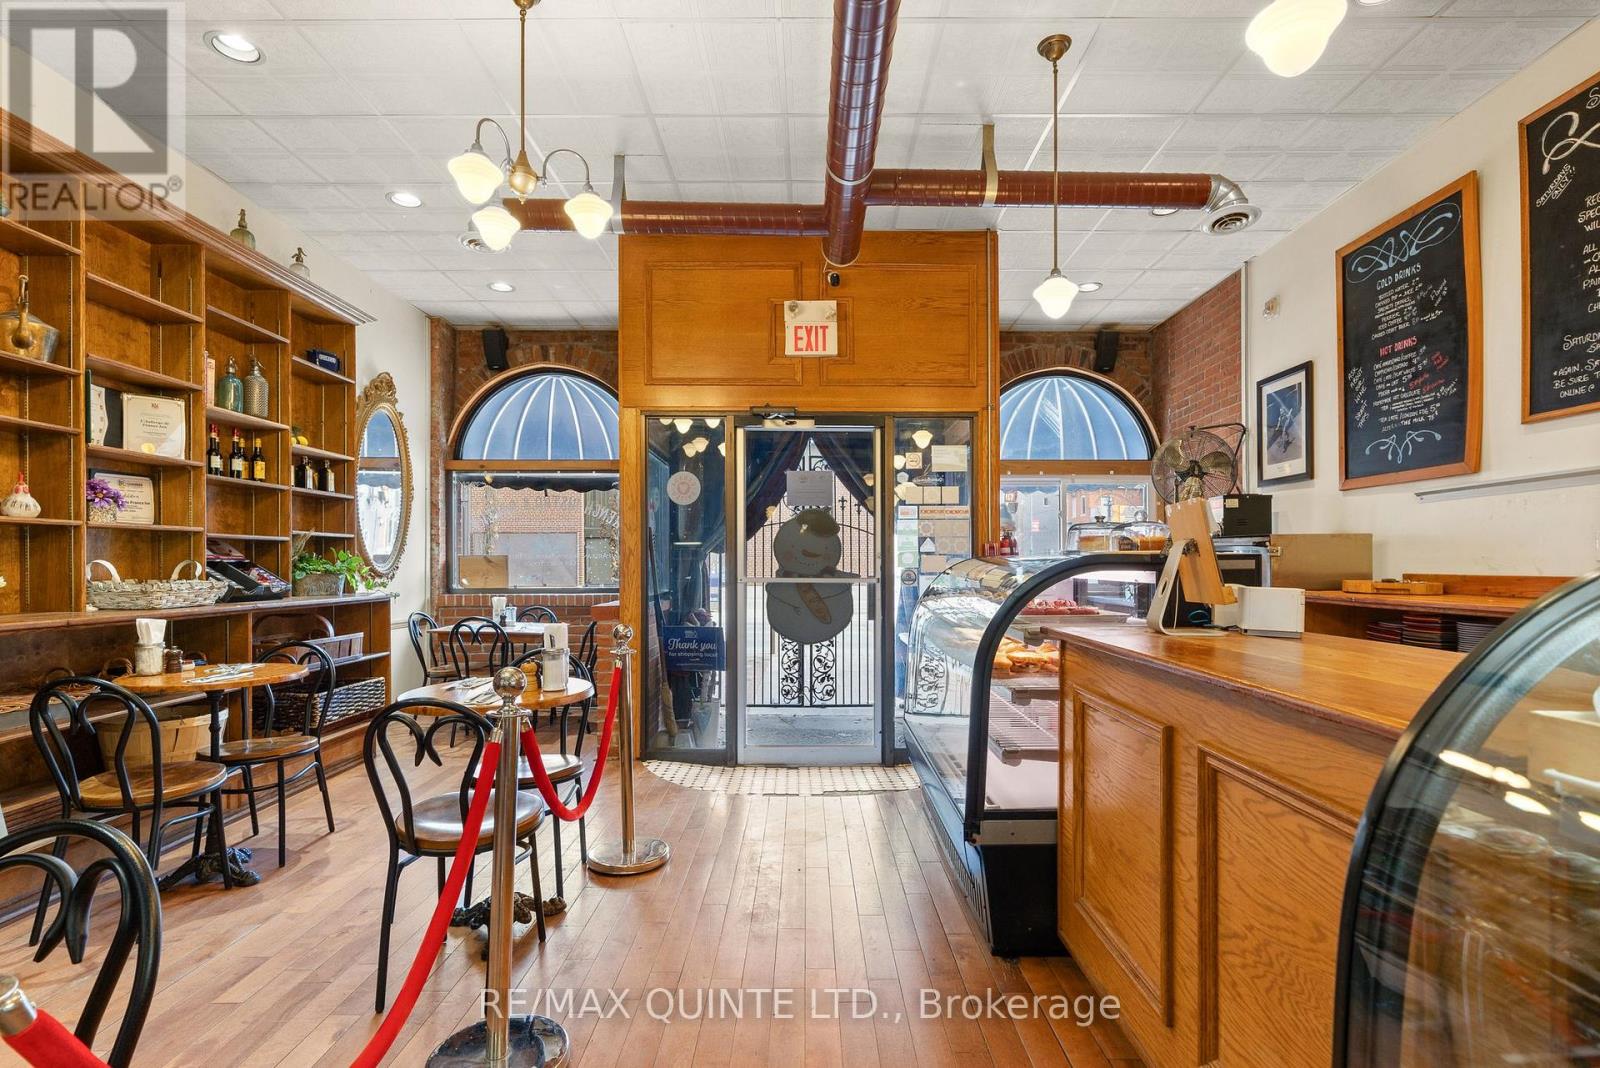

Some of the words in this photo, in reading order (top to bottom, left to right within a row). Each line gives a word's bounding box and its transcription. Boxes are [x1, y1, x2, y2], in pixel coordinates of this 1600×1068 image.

[1536, 164, 1571, 207] SATURDAYS
[1376, 276, 1393, 290] COLD
[1394, 262, 1422, 282] DRINKS
[794, 325, 829, 352] EXIT
[1394, 335, 1418, 352] DRINKS
[1350, 366, 1363, 388] ABOUT
[1553, 379, 1566, 389] BE
[1567, 374, 1590, 385] SURE
[1354, 385, 1367, 404] WINE
[1560, 385, 1587, 398] ONLINE
[668, 638, 699, 651] Thank
[700, 641, 718, 652] you
